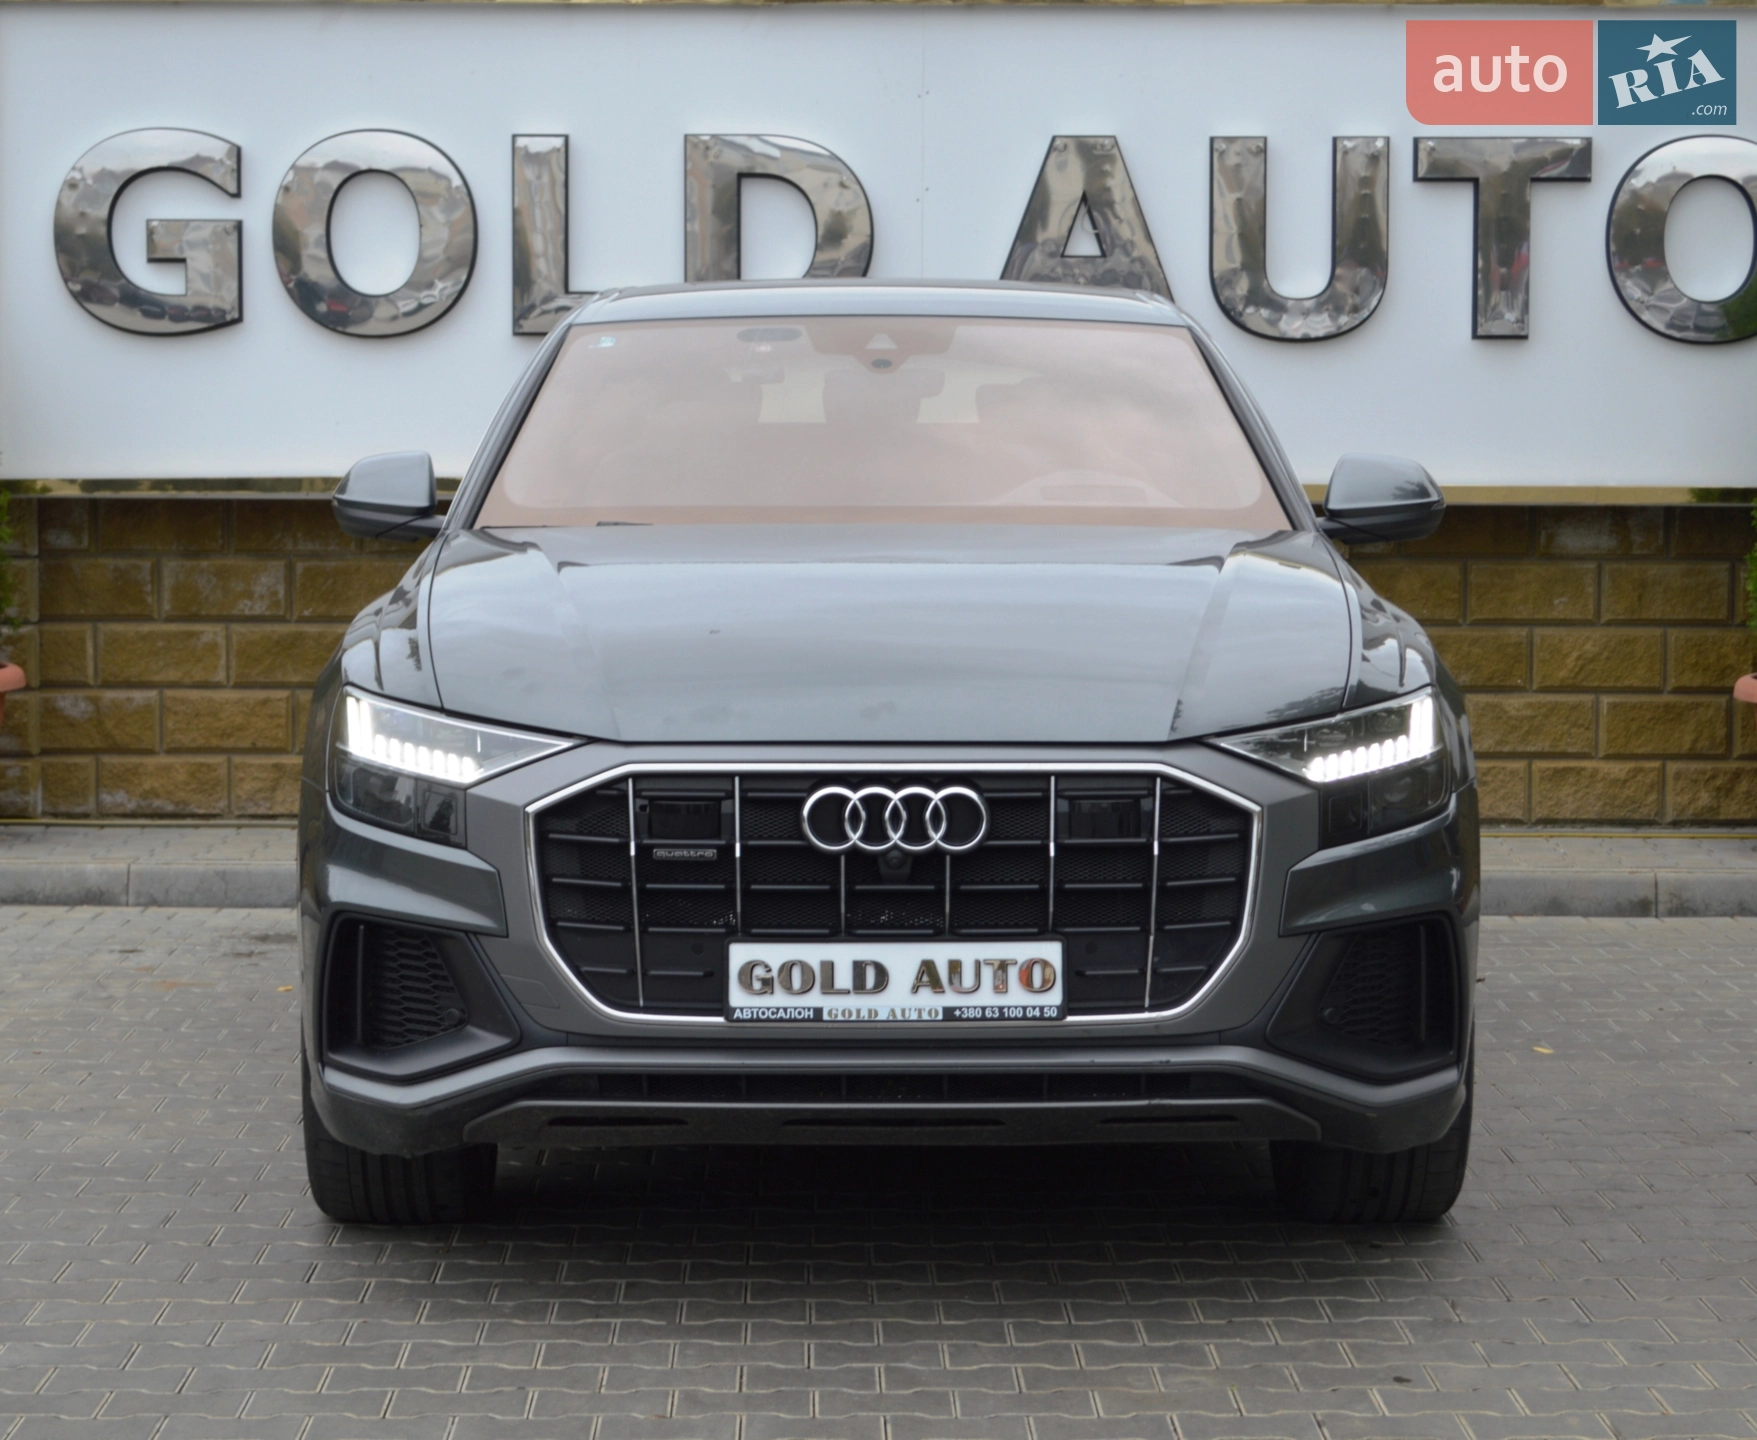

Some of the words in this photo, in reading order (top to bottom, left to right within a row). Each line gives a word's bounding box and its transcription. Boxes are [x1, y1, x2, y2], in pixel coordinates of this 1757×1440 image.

[53, 126, 875, 337] GOLD
[999, 134, 1757, 345] AUTO
[656, 850, 714, 859] quattro
[737, 959, 890, 995] GOLD
[911, 957, 1057, 994] AUTO
[733, 1007, 814, 1020] АВТОСАЛОН
[827, 1008, 879, 1020] GOLD
[886, 1008, 941, 1020] AUTO
[953, 1007, 983, 1019] +380
[985, 1007, 1000, 1018] 63
[1002, 1007, 1023, 1018] 100
[1025, 1006, 1041, 1018] 04
[1043, 1006, 1058, 1018] 50
